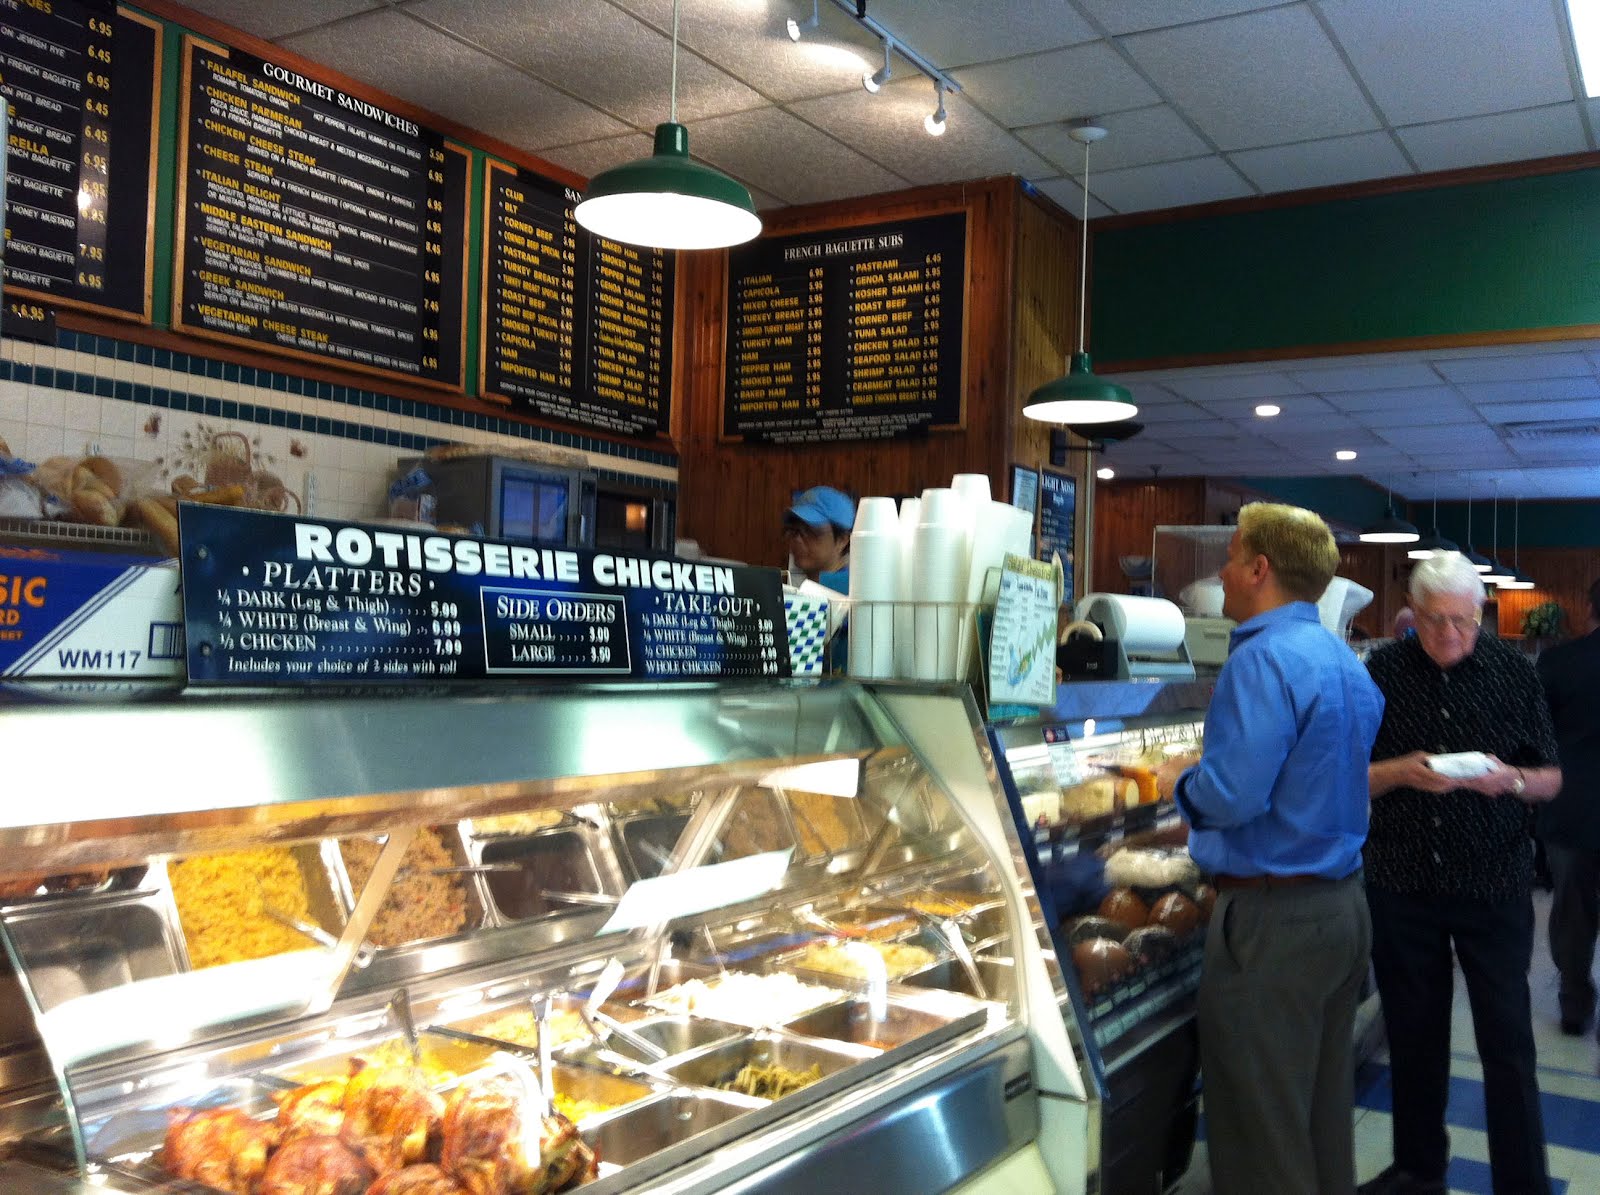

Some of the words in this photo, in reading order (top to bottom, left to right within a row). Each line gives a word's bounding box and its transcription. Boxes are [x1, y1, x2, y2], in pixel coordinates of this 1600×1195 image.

[89, 18, 112, 38] 6.95
[16, 33, 48, 50] JEWISH
[50, 45, 66, 58] RYE
[88, 45, 111, 63] 6.45
[7, 58, 40, 76] FRENCH
[42, 70, 81, 92] BAGUETTE
[87, 71, 110, 90] 6.95
[206, 60, 248, 84] FALAFEL
[252, 78, 301, 105] SANDWICH
[15, 90, 33, 103] PITA
[35, 97, 62, 112] BREAD
[86, 98, 109, 117] 6.45
[206, 85, 248, 110] CHICKEN
[251, 102, 302, 130] PARMESAN
[262, 62, 335, 102] GOURMET
[337, 92, 419, 137] SANDWICHES
[16, 120, 43, 134] WHEAT
[45, 130, 72, 144] BREAD
[85, 125, 108, 143] 6.45
[7, 132, 49, 157] RELLA
[31, 152, 71, 173] BAGUETTE
[204, 118, 246, 141] CHICKEN
[249, 135, 285, 155] CHEESE
[288, 148, 317, 167] STEAK
[426, 197, 442, 212] 6.95
[202, 169, 240, 190] ITALIAN
[243, 183, 281, 203] DELIGHT
[428, 169, 444, 184] 6.95
[23, 180, 64, 199] BAGUETTE
[203, 143, 240, 165] CHEESE
[244, 158, 274, 177] STEAK
[426, 219, 442, 234] 6.95
[505, 187, 524, 203] CLUB
[12, 205, 39, 220] HONEY
[41, 212, 75, 230] MUSTARD
[504, 201, 518, 215] BLT
[200, 201, 237, 222] MIDDLE
[241, 214, 283, 236] EASTERN
[285, 228, 332, 251] SANDWICH
[504, 216, 534, 235] CORNED
[6, 241, 37, 256] FRENCH
[38, 249, 75, 265] BAGUETTE
[784, 245, 821, 260] FRENCH
[825, 239, 875, 257] BAGUETTE
[878, 233, 904, 249] SUBS
[201, 236, 260, 262] VEGETARIAN
[264, 254, 312, 277] SANDWICH
[855, 259, 898, 274] PASTRAMI
[926, 253, 941, 265] 6.45
[503, 260, 531, 277] TURKEY
[855, 273, 884, 287] GENOA
[888, 269, 919, 282] SALAMI
[12, 271, 51, 287] BAGUETTE
[79, 271, 103, 290] 6.95
[199, 270, 231, 288] GREEK
[235, 279, 284, 301] SANDWICH
[743, 274, 772, 286] ITALIAN
[743, 286, 780, 299] CAPICOLA
[855, 286, 888, 300] KOSHER
[892, 282, 923, 296] SALAMI
[743, 300, 767, 312] MIXED
[770, 296, 799, 309] CHEESE
[855, 300, 882, 313] ROAST
[886, 298, 907, 310] BEEF
[198, 303, 258, 328] VEGETARIAN
[262, 319, 297, 336] CHEESE
[301, 327, 329, 343] STEAK
[743, 312, 772, 324] TURKEY
[775, 309, 804, 321] BREAST
[855, 313, 889, 327] CORNED
[891, 310, 913, 322] BEEF
[855, 328, 877, 340] TUNA
[880, 324, 908, 337] SALAD
[742, 337, 771, 350] TURKEY
[774, 335, 792, 347] HAM
[854, 340, 889, 354] CHICKEN
[892, 336, 920, 350] SALAD
[853, 353, 890, 366] SEAFOOD
[894, 350, 921, 363] SALAD
[853, 366, 884, 379] SHRIMP
[888, 364, 915, 376] SALAD
[852, 379, 892, 392] CRABMEAT
[895, 377, 921, 390] SALAD
[295, 523, 580, 583] ROTISSERIE
[592, 553, 735, 595] CHICKEN
[263, 561, 422, 598] PLATTERS
[236, 590, 286, 609] DARK
[291, 593, 321, 613] (Leg
[326, 595, 341, 612] &
[497, 595, 540, 620] SIDE
[546, 598, 616, 623] ORDERS
[238, 611, 298, 631] WHITE
[303, 614, 348, 633] (Breast
[353, 616, 368, 634] &
[372, 617, 411, 638] Wing)
[652, 612, 679, 628] DARK
[700, 615, 708, 627] &
[240, 633, 316, 651] CHICKEN
[509, 622, 556, 641] SMALL
[588, 626, 610, 643] 3.00
[653, 629, 687, 645] WHITE
[58, 649, 141, 669] WM117
[511, 644, 556, 662] LARGE
[655, 645, 697, 660] CHICKEN
[229, 656, 281, 673] Includes
[286, 661, 313, 675] your
[318, 658, 353, 674] choice
[357, 658, 369, 674] of
[384, 660, 409, 674] sides
[412, 660, 435, 674] with
[439, 660, 457, 675] roll
[645, 660, 680, 676] WHOLE
[682, 660, 721, 676] CHICKEN
